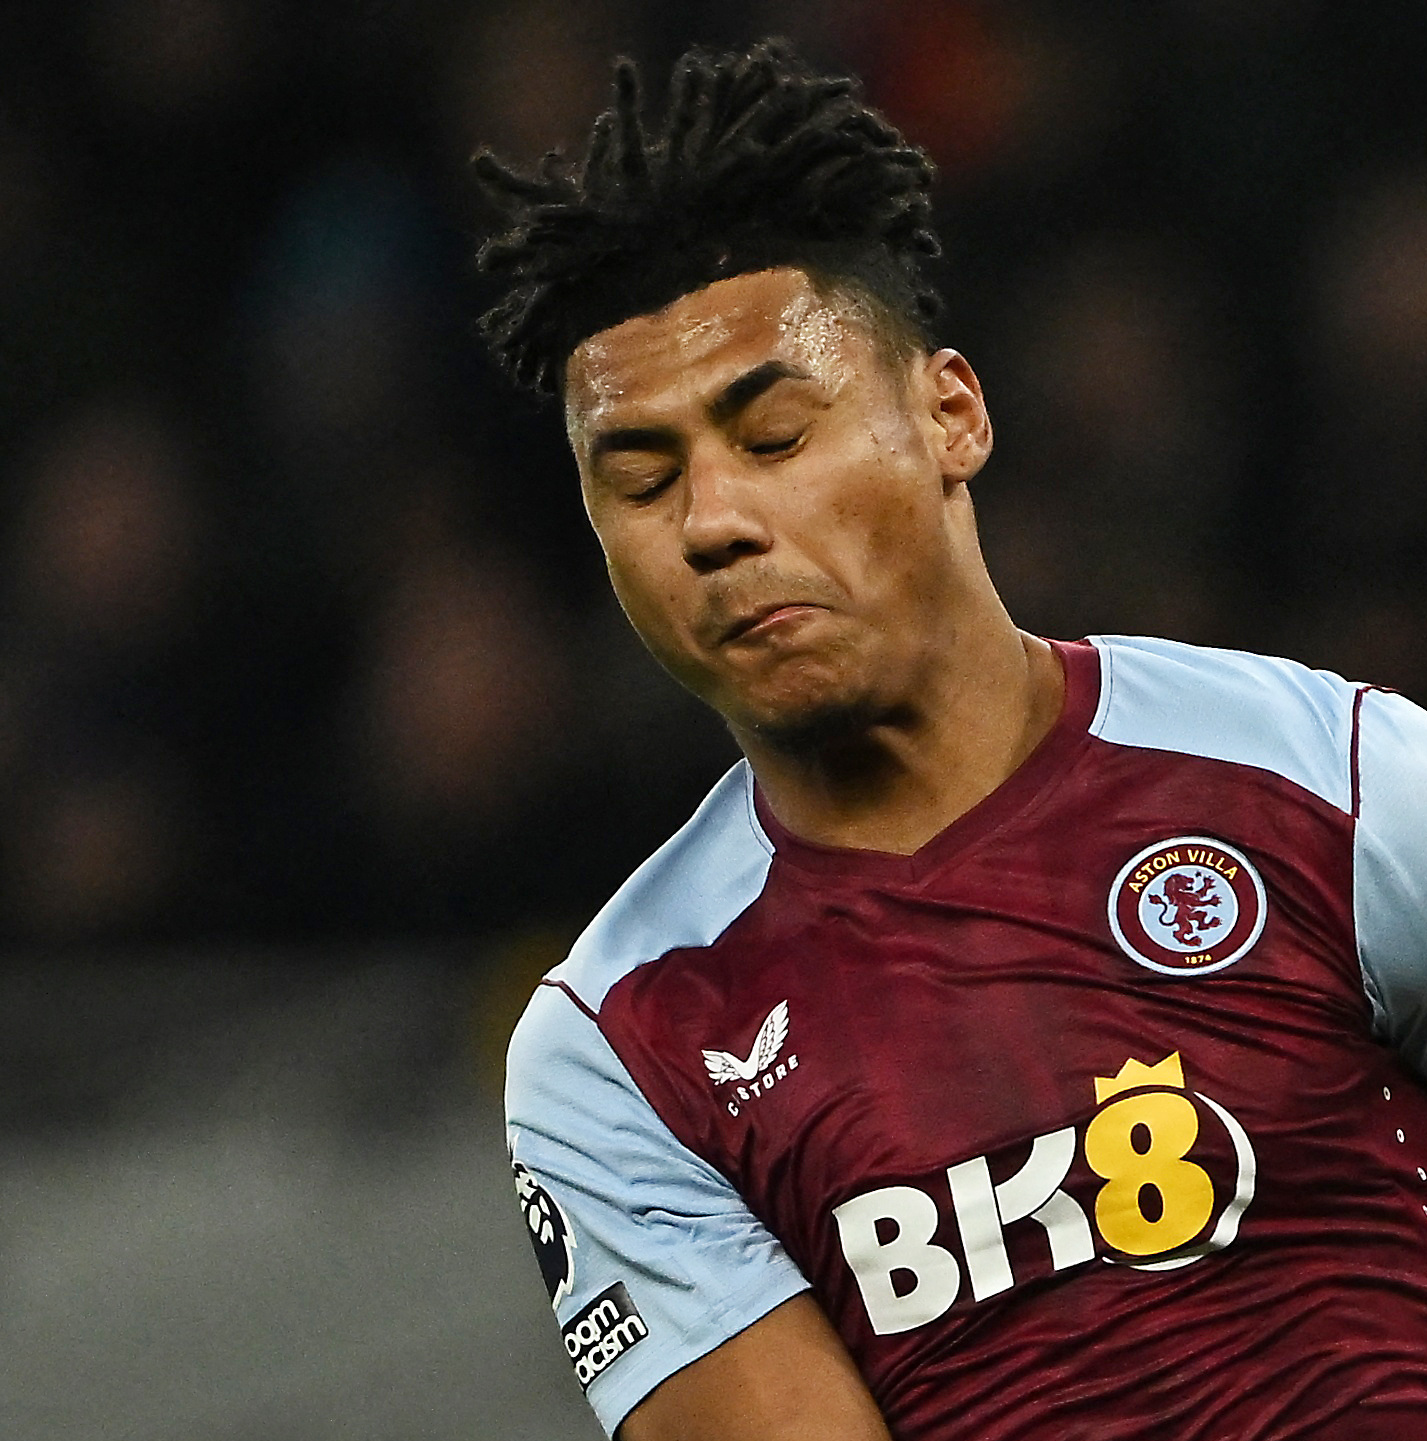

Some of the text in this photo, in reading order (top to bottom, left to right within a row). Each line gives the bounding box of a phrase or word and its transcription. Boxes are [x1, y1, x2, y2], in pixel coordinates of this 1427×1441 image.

[1127, 848, 1238, 894] ASTON VILLA
[1184, 954, 1212, 965] 1874
[727, 1053, 799, 1117] CSTORE
[833, 1090, 1215, 1336] BK8
[564, 1299, 620, 1358] oom
[574, 1314, 648, 1384] acism
